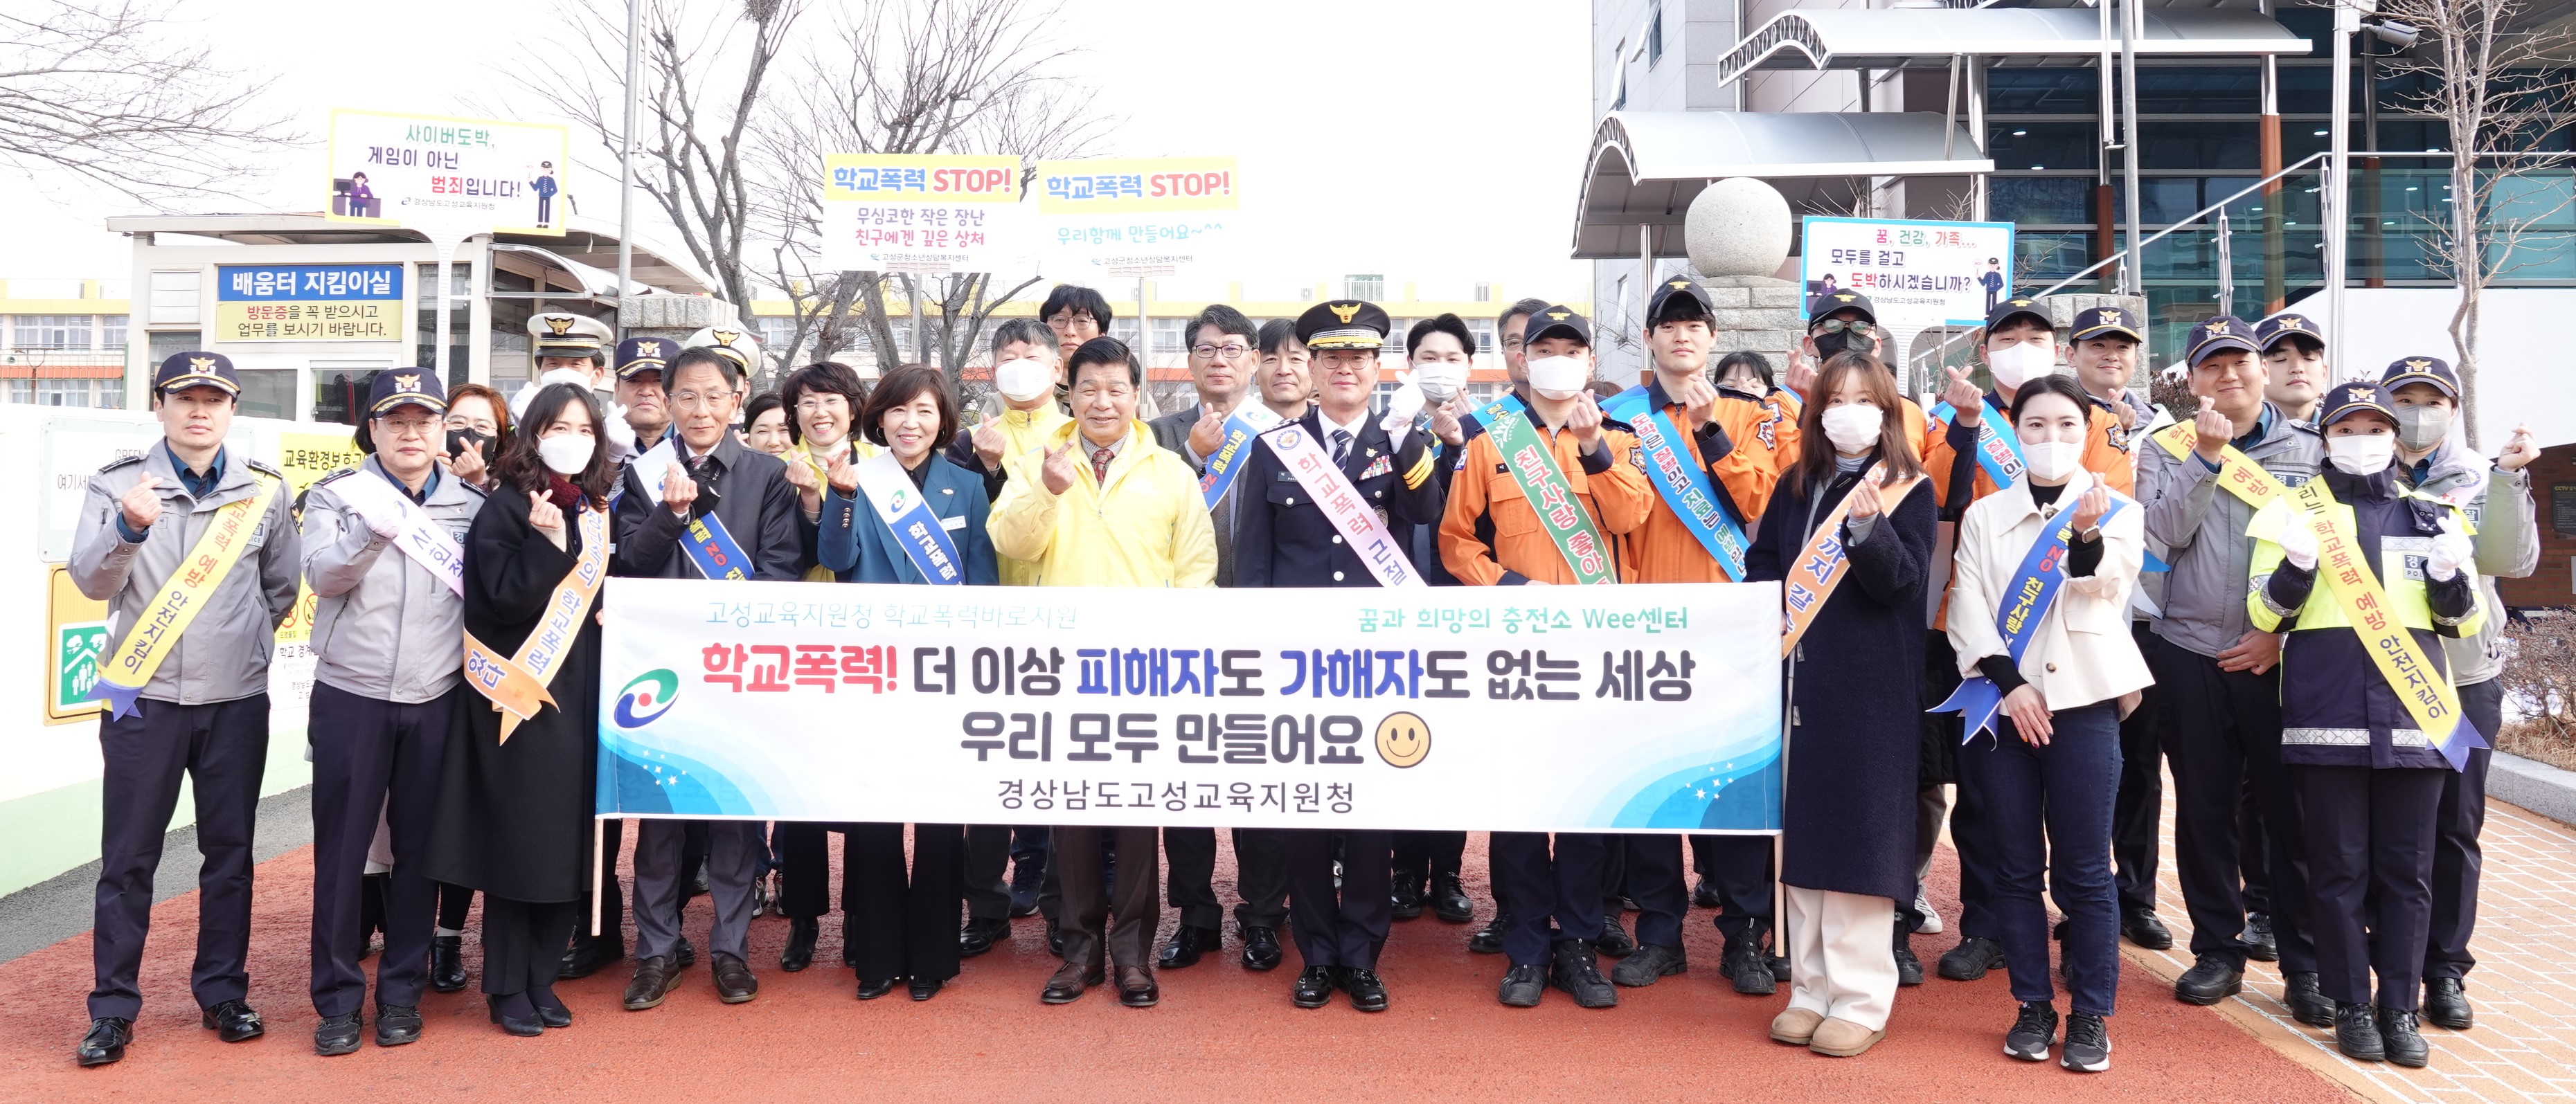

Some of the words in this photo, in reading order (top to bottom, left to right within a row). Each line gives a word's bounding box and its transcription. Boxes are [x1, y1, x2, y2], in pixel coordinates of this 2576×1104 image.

[406, 124, 495, 148] 사이버도박,
[368, 146, 417, 167] 게임이
[427, 150, 458, 170] 아닌
[431, 175, 521, 198] 범죄입니다!
[834, 168, 925, 191] 학교폭력
[933, 168, 1010, 192] STOP!
[1046, 174, 1143, 199] 학교폭력
[1150, 171, 1229, 197] STOP!
[413, 198, 495, 210] 경상남도고성교육지원청
[857, 208, 915, 226] 무심코한
[920, 208, 948, 226] 작은
[954, 208, 985, 226] 장난
[855, 228, 914, 246] 친구에겐
[921, 230, 949, 248] 깊은
[954, 230, 984, 248] 상처
[1057, 226, 1121, 245] 우리함께
[1877, 229, 1892, 244] 꿈,
[1899, 230, 1929, 246] 건강,
[1935, 231, 1975, 246] 가족...
[882, 253, 969, 262] 고성군청소년상담복지센터
[1103, 255, 1192, 265] 고성군청소년상담복지센터
[1832, 249, 1871, 266] 모두를
[1878, 250, 1904, 266] 걸고
[232, 271, 296, 296] 배움터
[304, 270, 391, 296] 지킴이실
[1851, 273, 1971, 291] 도박하시겠습니까?
[247, 305, 302, 320] 방문증을
[306, 306, 319, 320] 꼭
[324, 305, 379, 319] 받으시고
[1874, 296, 1946, 305] 경상남도고성교육지원청
[238, 323, 278, 337] 업무를
[283, 323, 323, 336] 보시기
[329, 323, 386, 336] 바랍니다.
[1212, 429, 1247, 475] 학교폭력
[1985, 437, 2026, 481] 질병이
[57, 474, 91, 491] 여기서
[1200, 473, 1218, 493] NO
[1631, 413, 1665, 449] 도박은
[1654, 447, 1691, 494] 질병이고
[1683, 488, 1721, 529] 치료는
[2233, 467, 2269, 496] 예방
[1298, 453, 1373, 535] 학교폭력
[1368, 539, 1407, 586] 근절
[1515, 445, 1577, 530] 친구사랑
[1567, 530, 1602, 575] 좋아
[705, 541, 727, 566] NO
[909, 521, 957, 580] 학교폭력
[2039, 545, 2064, 572] NO
[184, 554, 219, 588] 예방
[1788, 582, 1816, 613] 갈
[2006, 576, 2044, 635] 친구사랑
[706, 601, 873, 628] 고성교육지원청
[883, 603, 1077, 630] 학교폭력바로지원
[1358, 608, 1405, 633] 꿈과
[1417, 607, 1490, 634] 희망의
[1501, 606, 1573, 635] 충전소
[1582, 606, 1688, 634] Wee센터
[2314, 520, 2363, 586] 학교폭력
[2356, 591, 2386, 631] 예방
[2380, 635, 2448, 718] 안전지킴이
[125, 590, 188, 674] 안전지킴이
[527, 590, 582, 676] 학교폭력
[280, 646, 294, 659] 학교
[701, 642, 897, 694] 학교폭력!
[913, 646, 956, 695] 더
[972, 646, 1064, 696] 이상
[1076, 647, 1265, 697] 피해자도
[1280, 648, 1470, 698] 가해자도
[1486, 649, 1581, 700] 없는
[1595, 649, 1697, 702] 세상
[960, 711, 1053, 762] 우리
[1066, 712, 1159, 763] 모두
[1177, 712, 1364, 764] 만들어요
[998, 779, 1353, 814] 경상남도고성교육지원청
